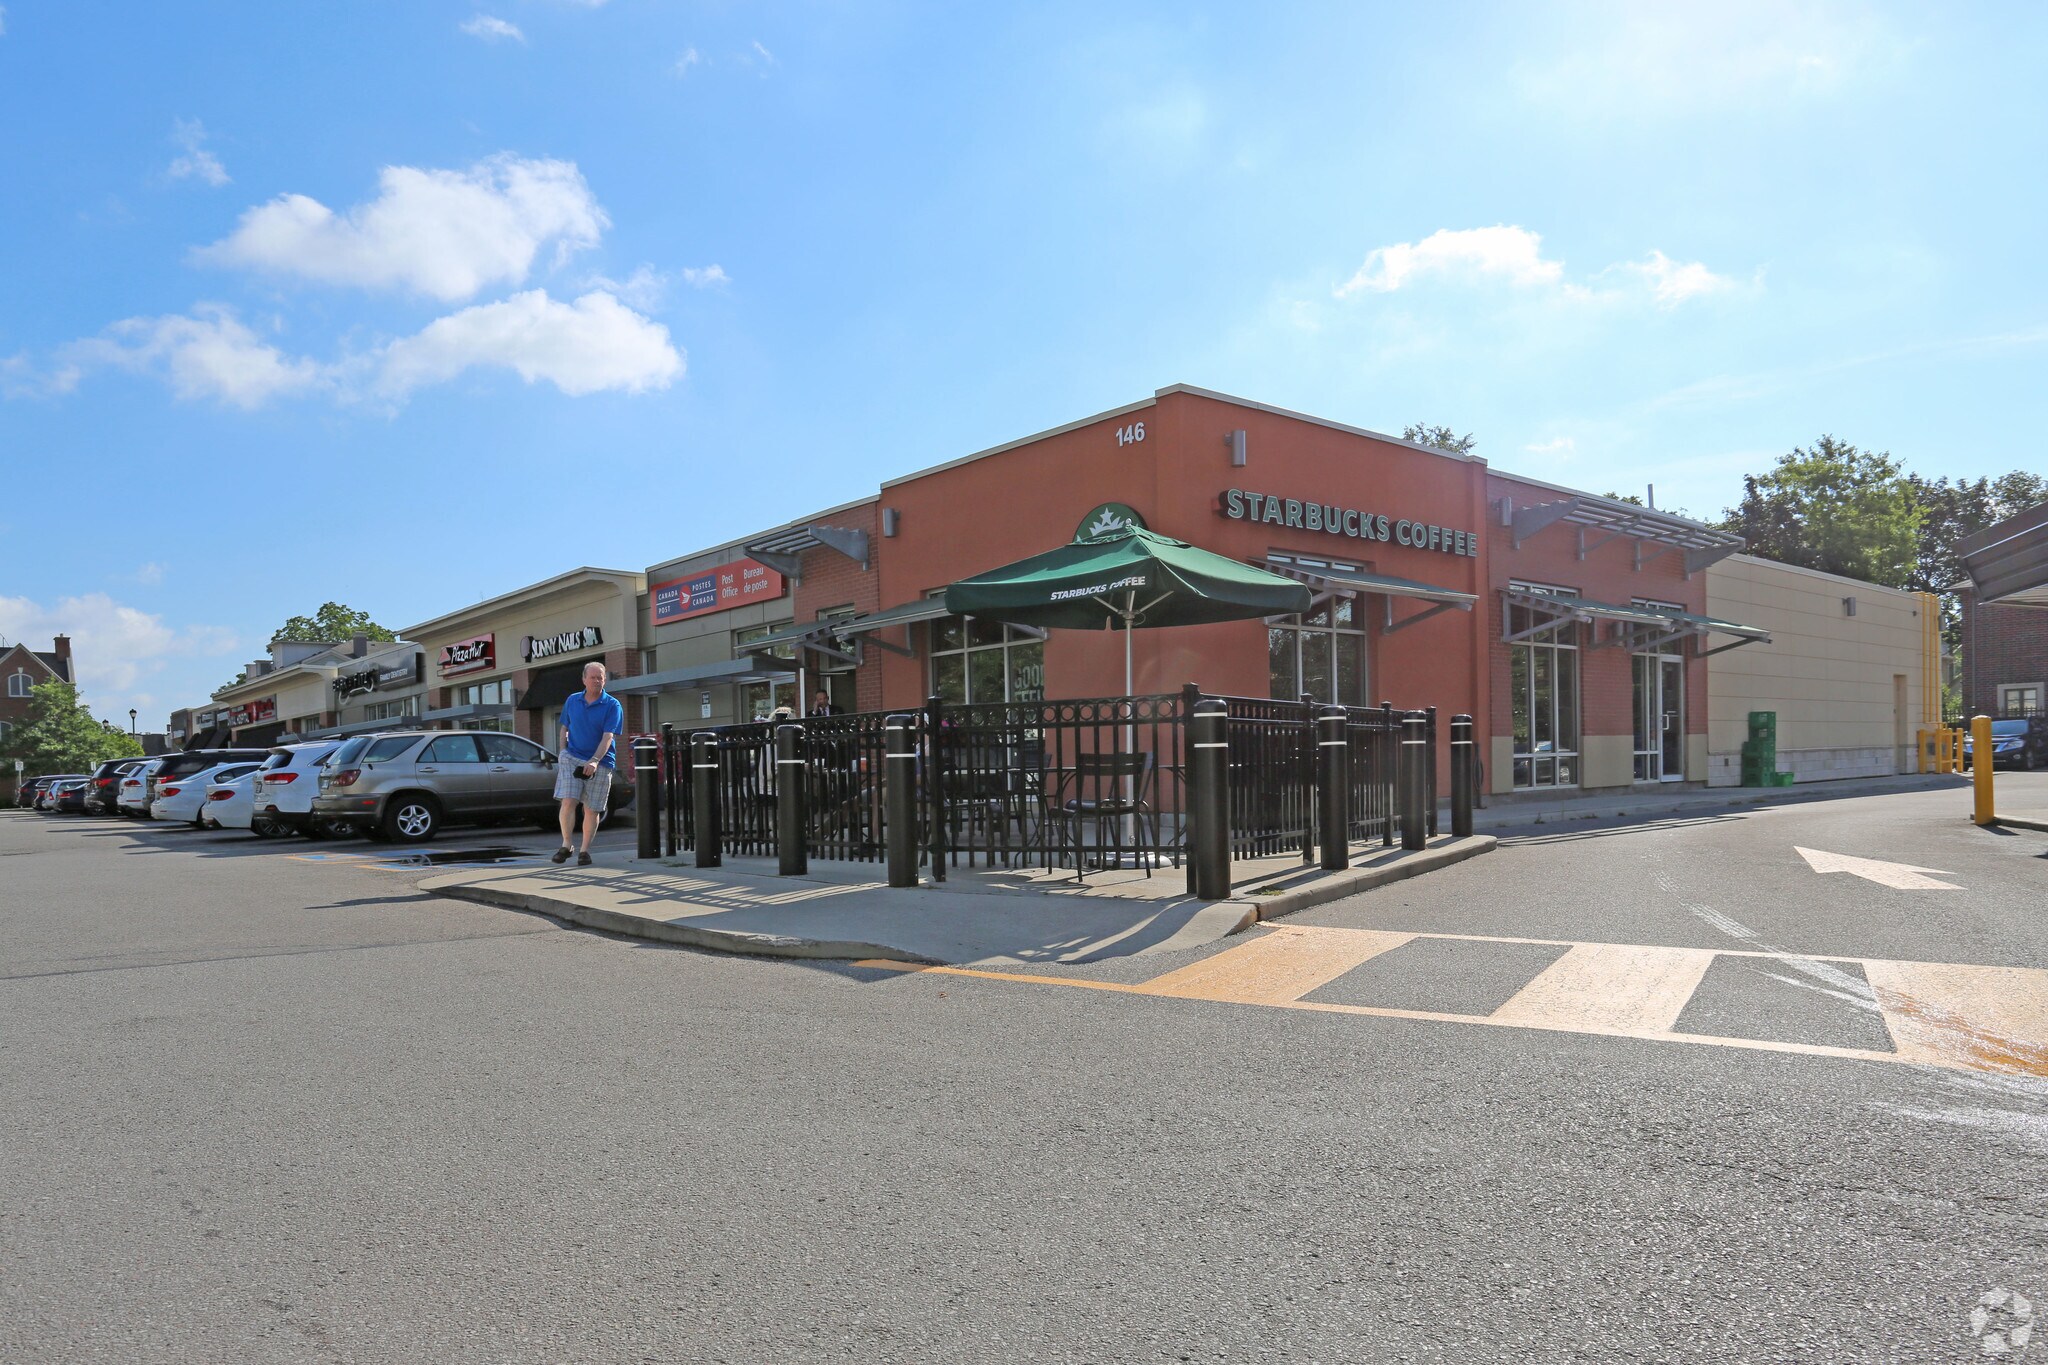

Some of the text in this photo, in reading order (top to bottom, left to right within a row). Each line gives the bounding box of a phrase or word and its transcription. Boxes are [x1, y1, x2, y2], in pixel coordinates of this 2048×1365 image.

[1115, 421, 1146, 447] 146
[1226, 489, 1478, 557] STARBUCKS COFFEE
[722, 567, 764, 585] Post Bureau
[658, 581, 712, 600] CANADA POSTES
[722, 579, 768, 598] Office de poste
[1050, 584, 1107, 601] STARBUCKS
[658, 595, 714, 614] POST CANADA
[531, 627, 598, 659] SUNNY NAILS SPA
[451, 642, 485, 664] Pizza Hut
